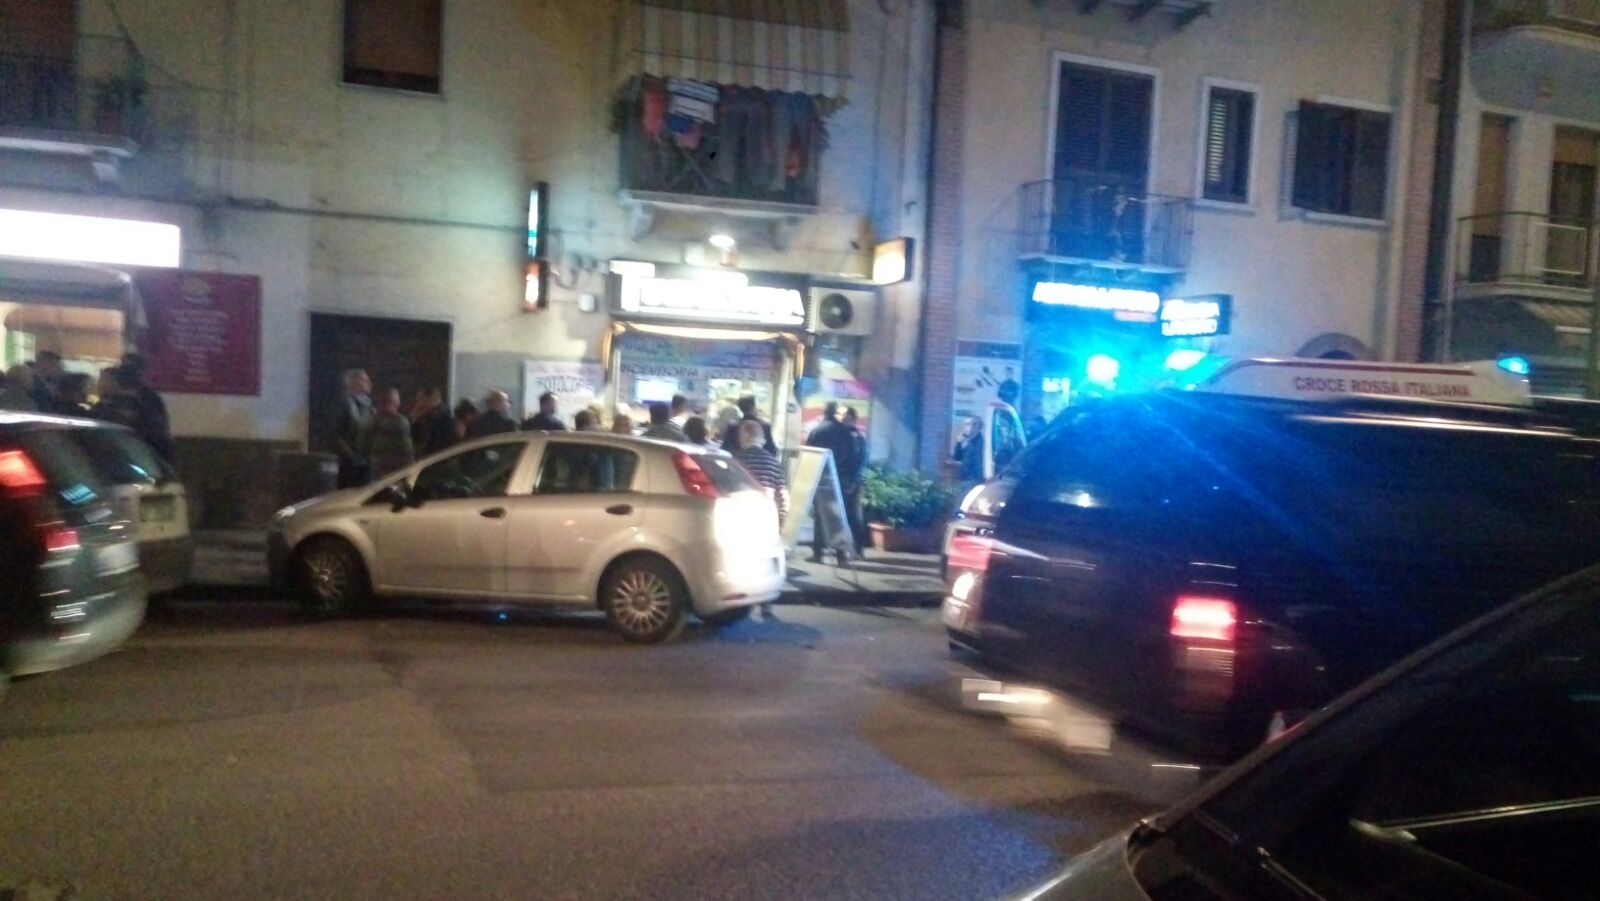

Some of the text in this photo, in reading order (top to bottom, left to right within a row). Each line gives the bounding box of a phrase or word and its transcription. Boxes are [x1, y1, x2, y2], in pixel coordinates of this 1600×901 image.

[1295, 377, 1472, 397] CROCE ROSSA ITALIANA
